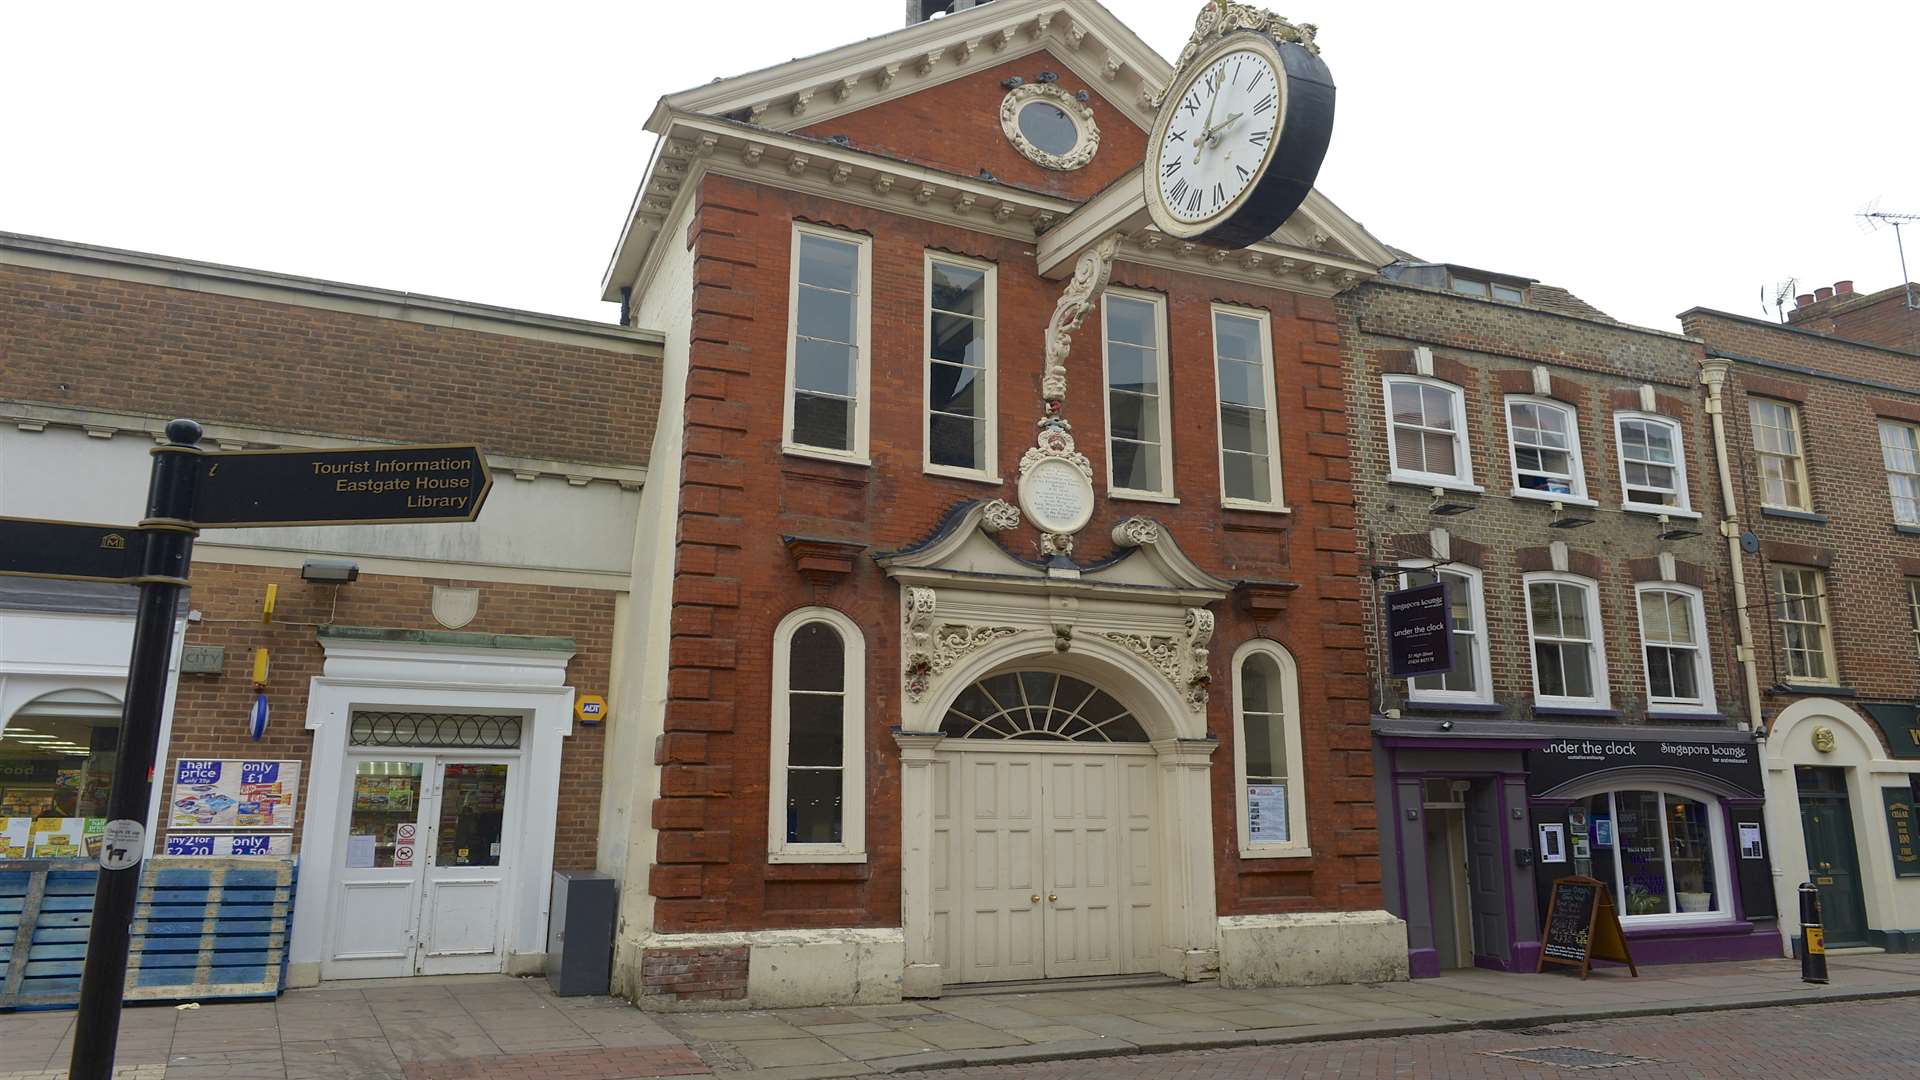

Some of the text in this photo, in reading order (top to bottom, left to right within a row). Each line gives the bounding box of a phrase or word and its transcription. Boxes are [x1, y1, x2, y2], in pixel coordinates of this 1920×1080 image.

[1185, 92, 1201, 117] XI
[1170, 130, 1187, 142] X
[312, 458, 471, 475] Tourist Information
[336, 476, 471, 494] Eastgate House
[407, 495, 468, 509] Library
[1394, 627, 1413, 636] under
[1414, 625, 1425, 633] the
[1426, 622, 1444, 632] clock
[185, 653, 220, 665] CITY
[583, 703, 600, 713] ADT
[1543, 739, 1637, 755] under the clock
[1660, 743, 1747, 758] Singapora Lounge
[187, 761, 212, 770] half
[243, 762, 273, 773] only
[181, 768, 216, 780] price
[247, 774, 263, 783] £1
[185, 836, 195, 845] 2
[233, 836, 263, 848] only
